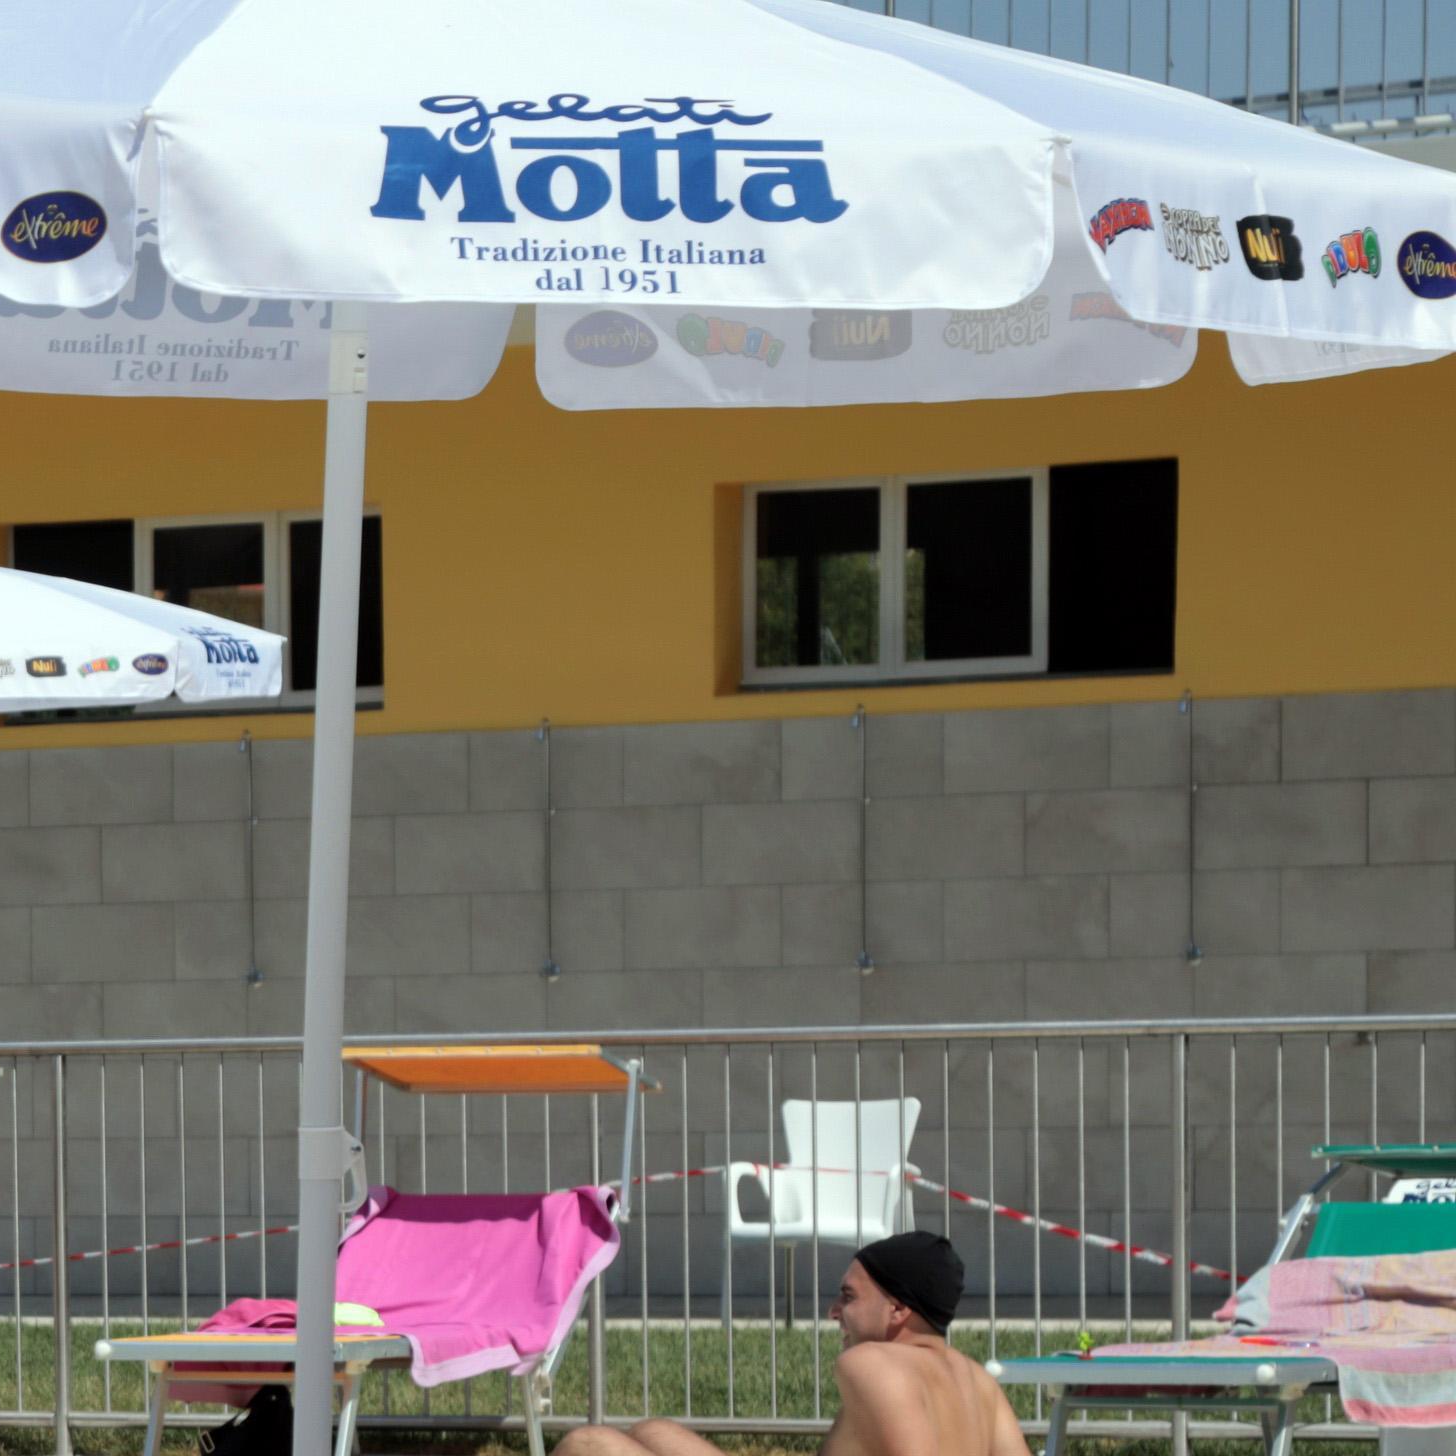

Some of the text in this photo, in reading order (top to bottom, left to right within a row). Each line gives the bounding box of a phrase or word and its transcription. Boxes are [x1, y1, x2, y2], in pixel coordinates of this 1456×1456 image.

[419, 93, 773, 146] gelati
[370, 125, 850, 224] Motta
[11, 207, 99, 250] extrême
[450, 236, 766, 266] Tradizione Italiana
[1163, 223, 1230, 270] NONNO
[535, 266, 682, 294] dal 1951
